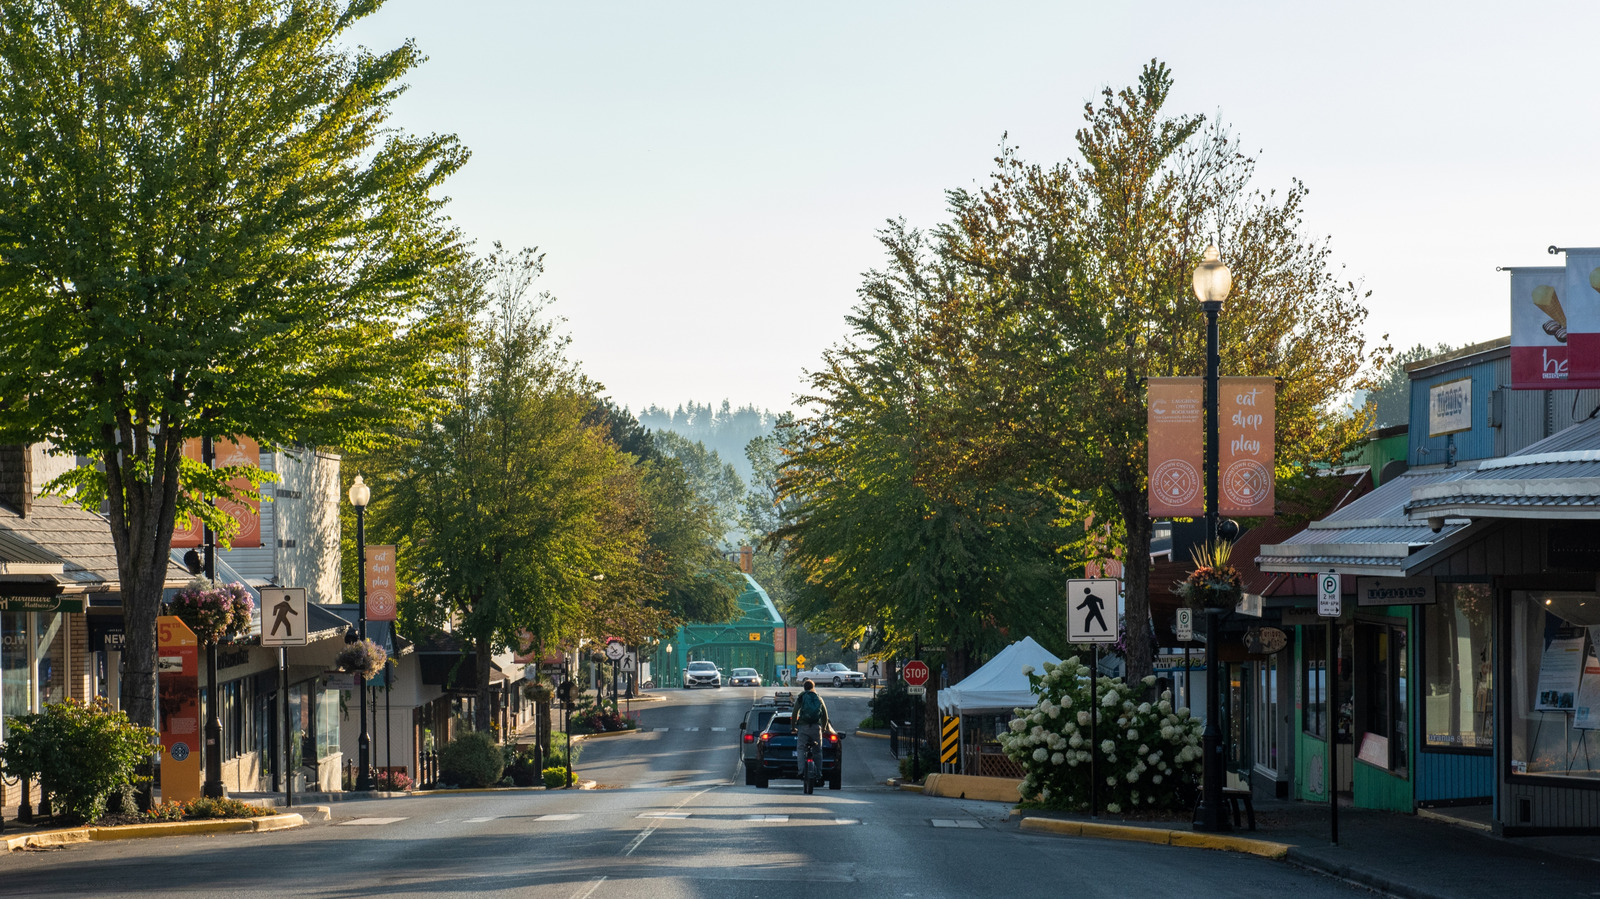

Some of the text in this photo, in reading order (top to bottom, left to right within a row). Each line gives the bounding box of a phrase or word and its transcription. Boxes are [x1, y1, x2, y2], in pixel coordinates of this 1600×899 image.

[1236, 387, 1263, 406] eat
[1232, 410, 1263, 430] shop
[1231, 434, 1260, 456] play
[1155, 462, 1196, 485] DOWNTOWN COURTENAY
[1226, 462, 1268, 485] DOWNTOWN COURTENAY
[1156, 488, 1194, 504] EXPERIENCE MORE
[1227, 488, 1266, 504] EXPERIENCE MORE
[374, 551, 389, 561] eat
[373, 563, 389, 574] shop
[373, 577, 389, 588] play
[1326, 580, 1333, 590] P
[905, 668, 927, 678] STOP
